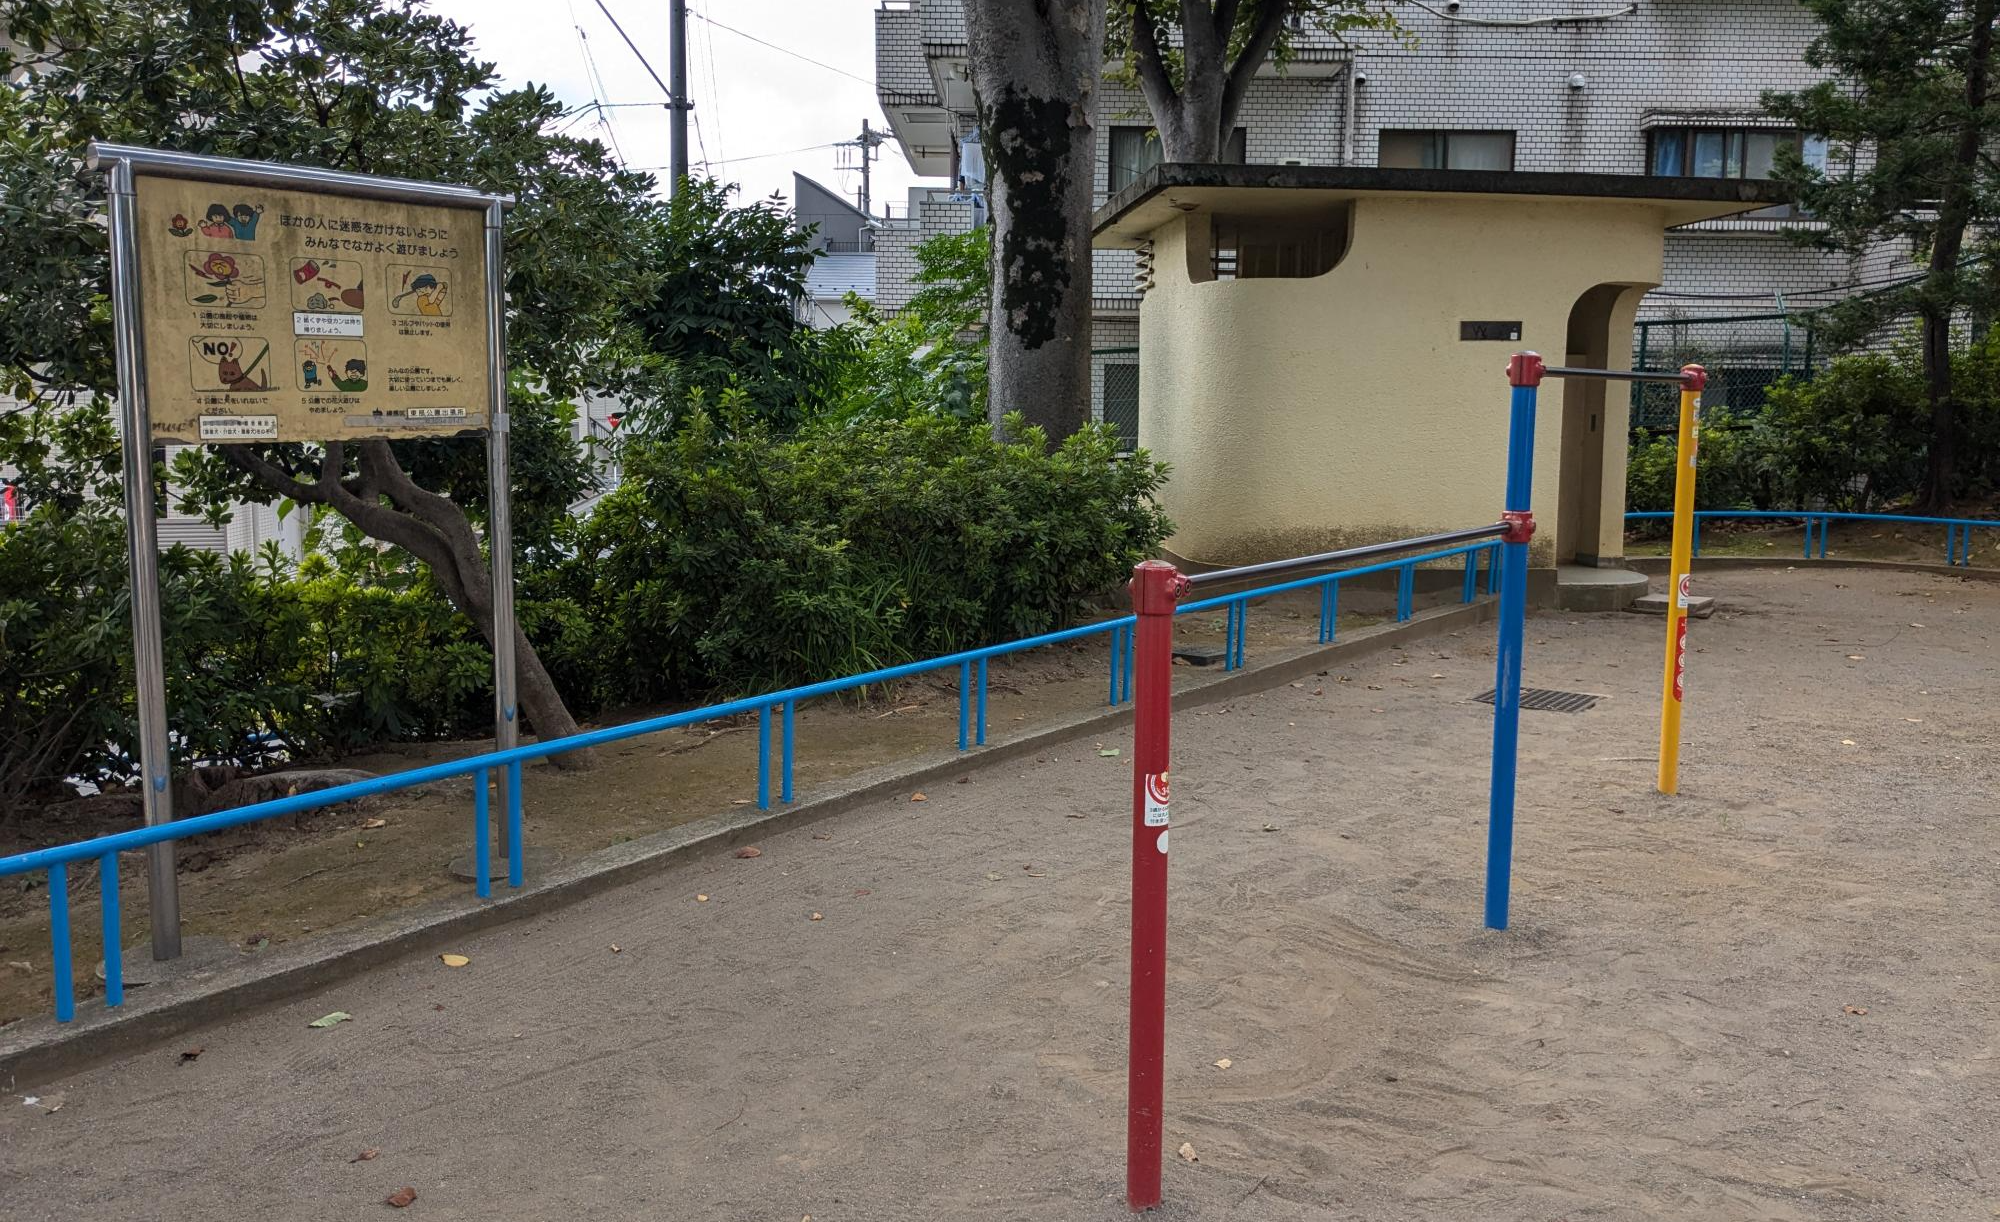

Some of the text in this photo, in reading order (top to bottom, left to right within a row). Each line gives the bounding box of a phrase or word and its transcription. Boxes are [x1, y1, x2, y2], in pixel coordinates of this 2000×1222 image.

[280, 214, 448, 240] ほかの人に迷惑をかけないように
[304, 235, 460, 259] みんなでなかよく遊びましょう
[202, 341, 237, 358] NO!
